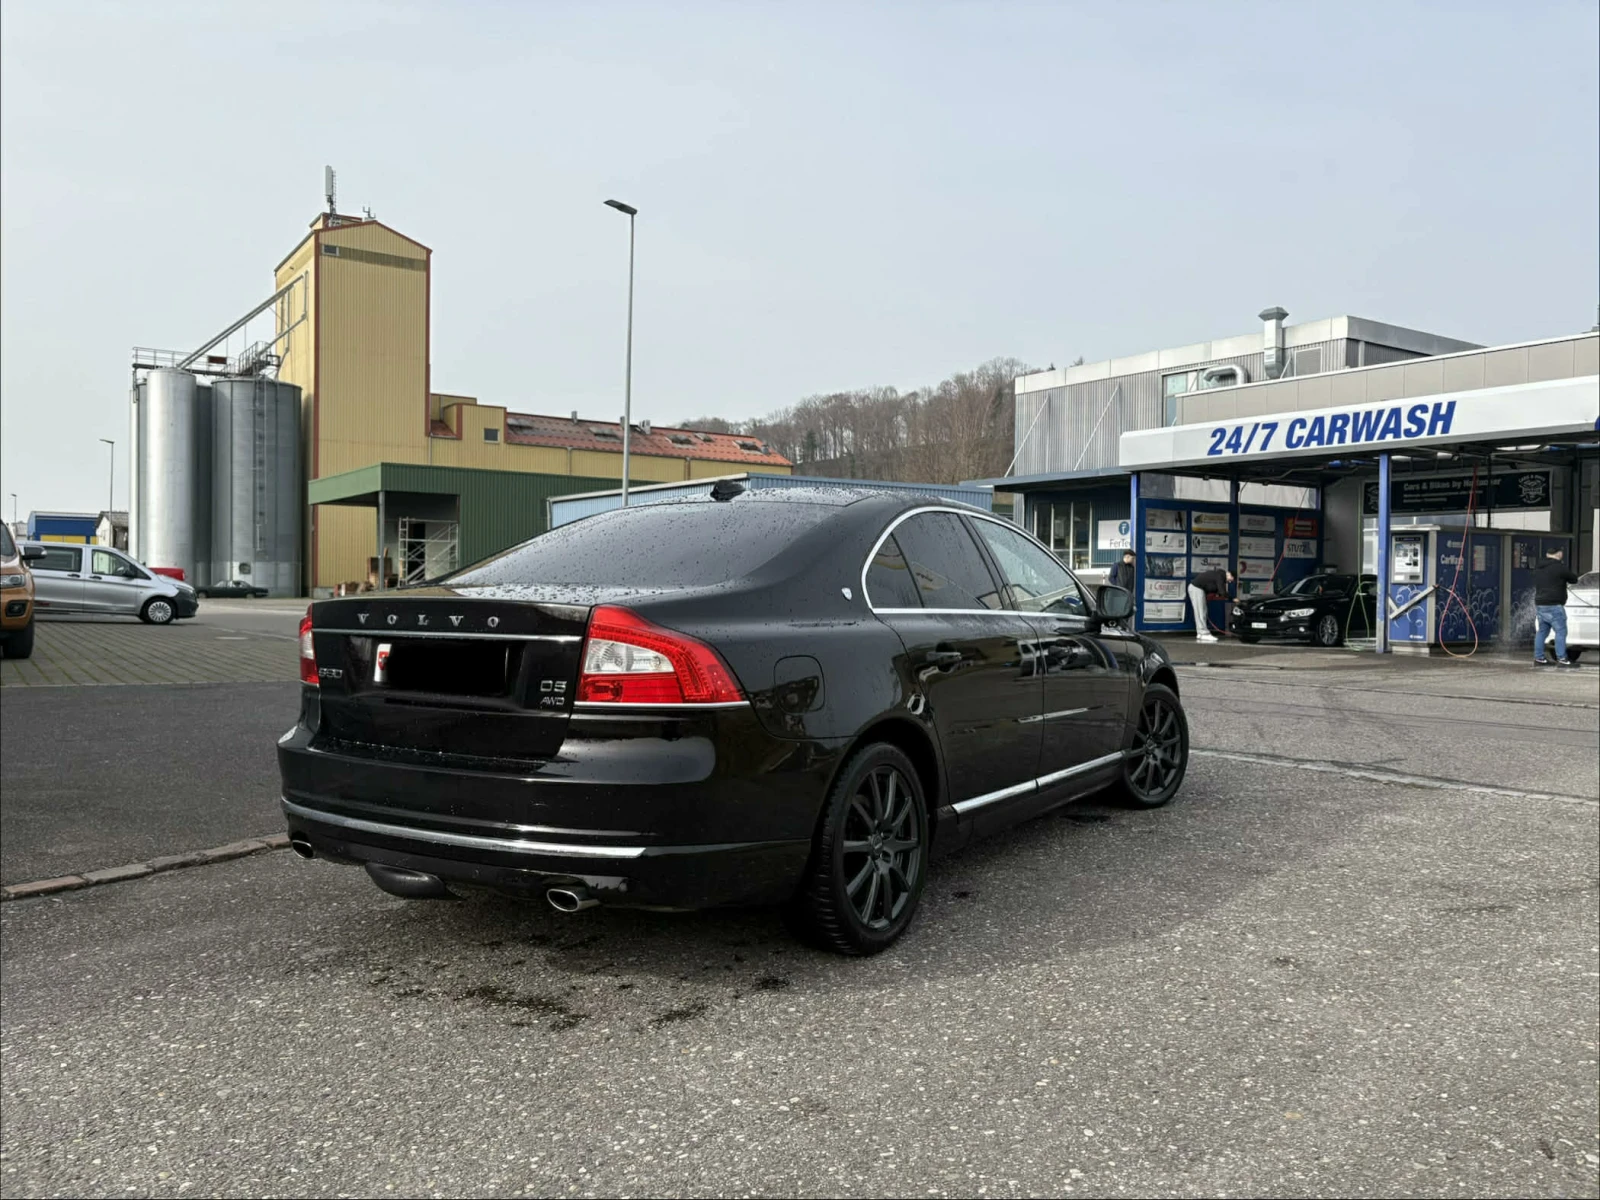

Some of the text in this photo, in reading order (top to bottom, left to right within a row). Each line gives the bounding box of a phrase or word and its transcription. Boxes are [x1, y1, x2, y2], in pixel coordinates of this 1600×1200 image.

[1207, 400, 1457, 456] 24/7 CARWASH
[357, 613, 500, 628] VOLVO
[540, 680, 568, 693] D5
[539, 696, 565, 706] AWD
